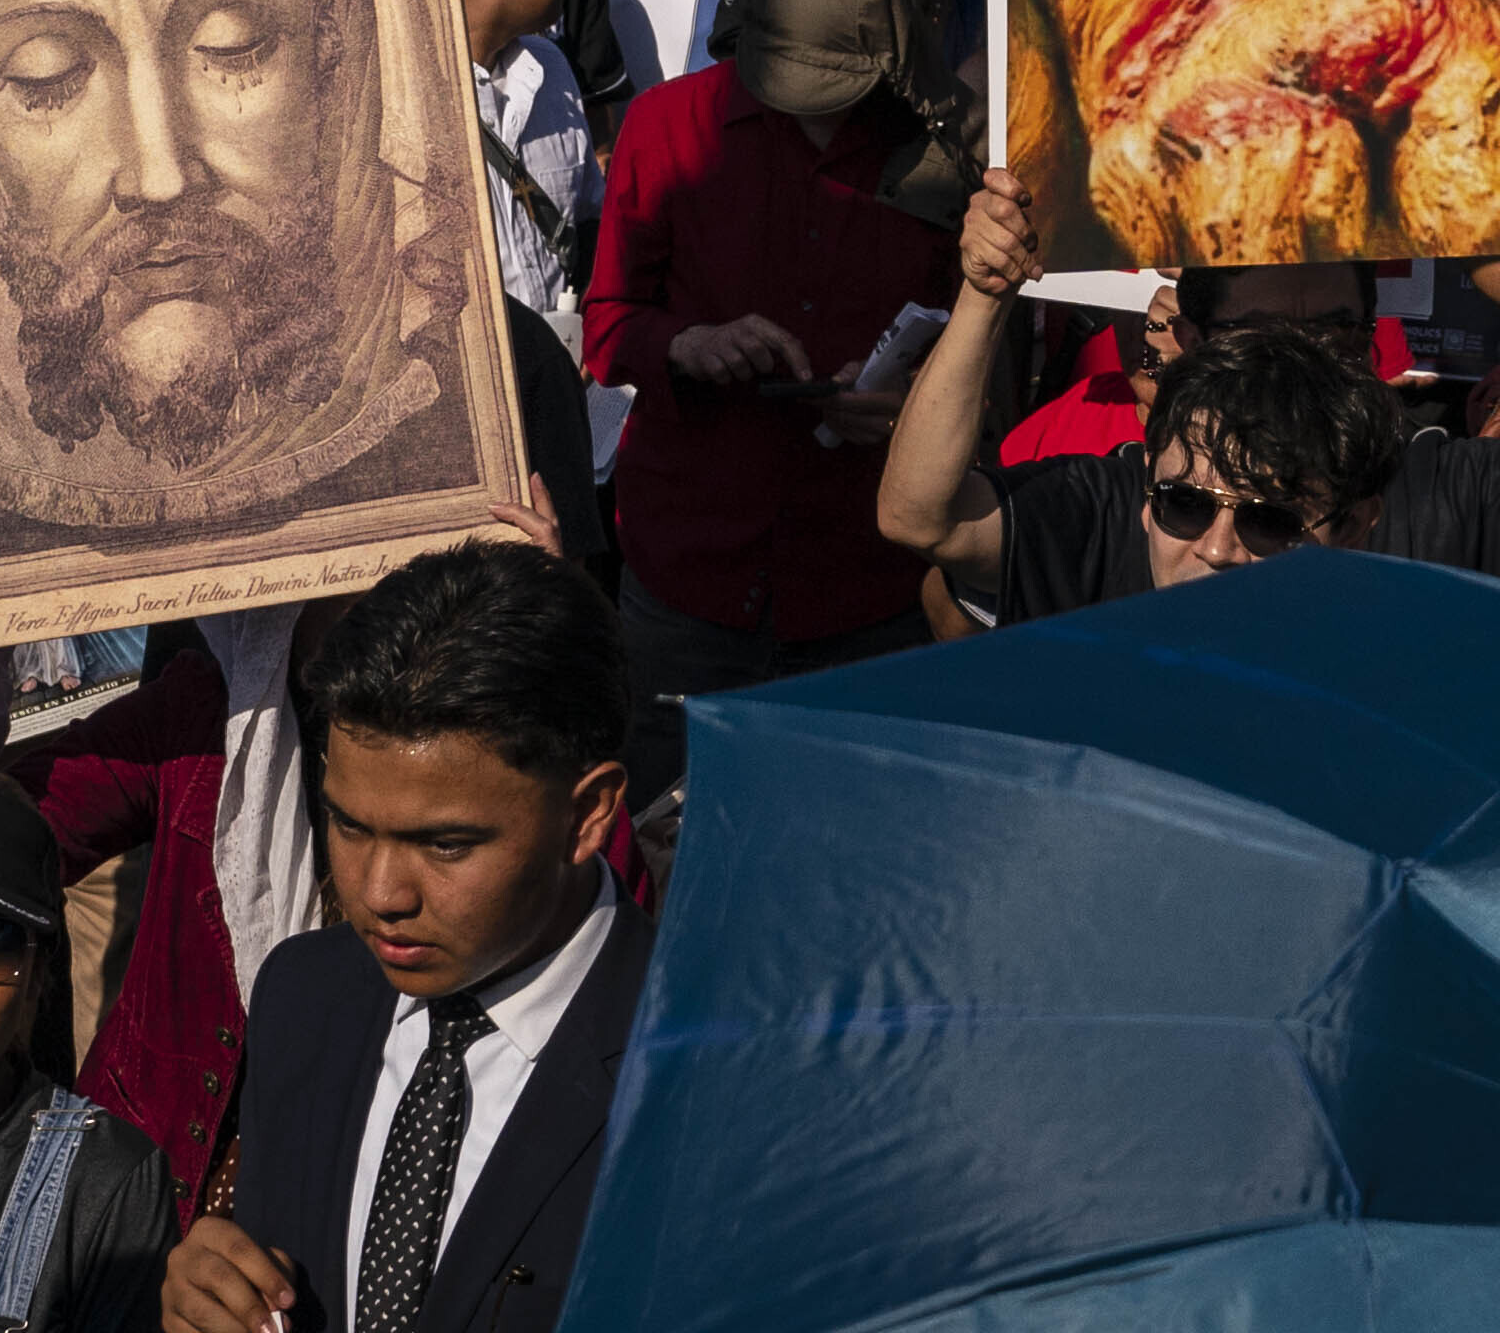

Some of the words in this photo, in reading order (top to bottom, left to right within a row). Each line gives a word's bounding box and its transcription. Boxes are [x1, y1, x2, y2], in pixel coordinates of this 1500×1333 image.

[5, 613, 51, 635] Vera
[53, 601, 122, 633] Effigies
[185, 583, 243, 609] Vultus
[243, 573, 313, 600] Domini
[316, 562, 369, 588] Nostri
